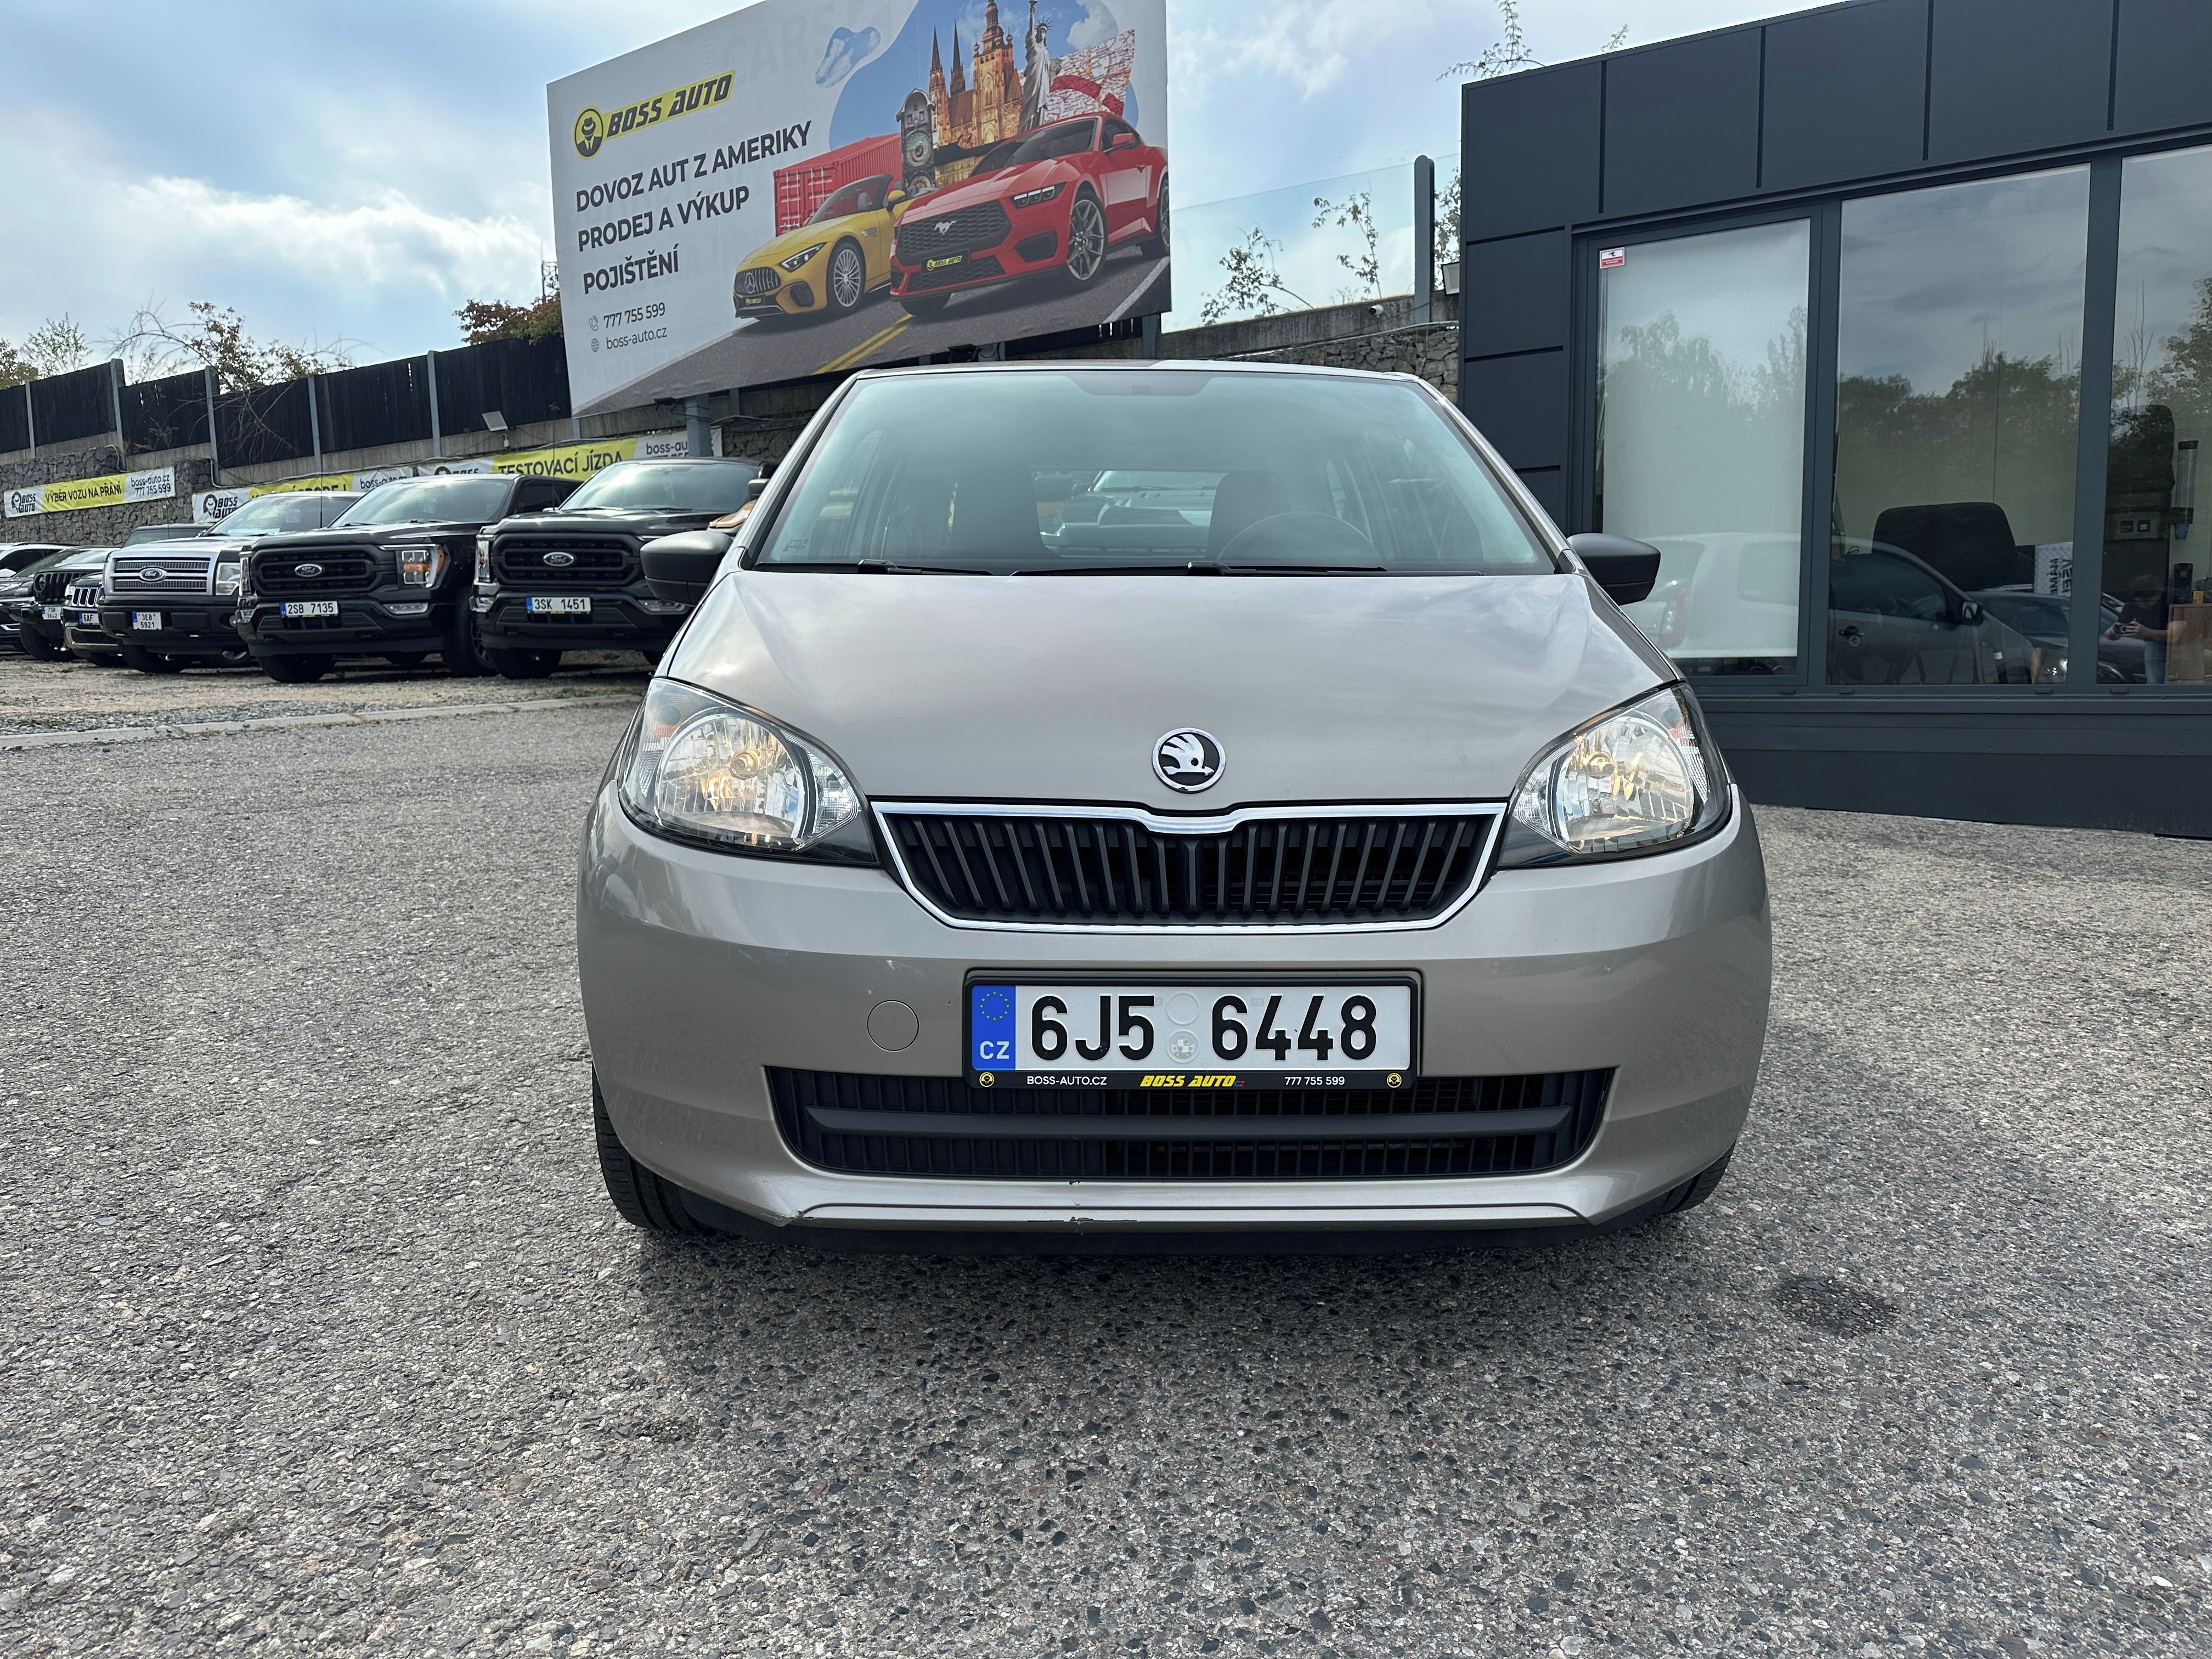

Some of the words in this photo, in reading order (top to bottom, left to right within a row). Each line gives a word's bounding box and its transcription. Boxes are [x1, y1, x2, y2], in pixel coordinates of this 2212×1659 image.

[607, 97, 663, 137] BOSS
[667, 75, 732, 117] AUTO
[576, 172, 644, 212] DOVOZ
[648, 159, 689, 191] AUT
[693, 153, 707, 178] Z
[712, 120, 812, 173] AMERIKY
[578, 211, 653, 252] PRODEJ
[658, 207, 674, 230] A
[677, 186, 749, 224] VÝKUP
[583, 243, 679, 294] POJIŠTĚNÍ
[603, 312, 622, 329] 777
[624, 307, 643, 324] 755
[646, 302, 665, 319] 599
[606, 328, 667, 349] boss-auto.cz
[646, 441, 688, 455] boss-au
[582, 449, 623, 472] JÍZDA
[131, 475, 170, 487] boss-auto.cz
[45, 489, 67, 503] VÝBĚR
[67, 489, 87, 500] VOZU
[88, 487, 99, 498] NA
[100, 481, 122, 496] PŘÁNÍ
[135, 487, 145, 496] 777
[146, 485, 157, 495] 755
[158, 483, 171, 493] 599
[22, 494, 36, 503] BOSS
[218, 496, 238, 507] BOSS
[20, 503, 35, 513] AUTO
[214, 507, 237, 518] AUT
[287, 604, 304, 614] 2SB
[311, 603, 334, 613] 7135
[534, 599, 552, 610] 3SK
[561, 599, 585, 610] 1451
[1031, 995, 1154, 1060] 6J5
[1212, 995, 1376, 1060] 6448
[980, 1041, 1009, 1059] CZ
[1027, 1076, 1107, 1085] BOSS-AUTO.CZ
[1139, 1075, 1186, 1087] BOSS
[1187, 1075, 1237, 1087] AUTO
[1284, 1076, 1302, 1085] 777
[1304, 1076, 1323, 1085] 755
[1325, 1076, 1345, 1085] 599
